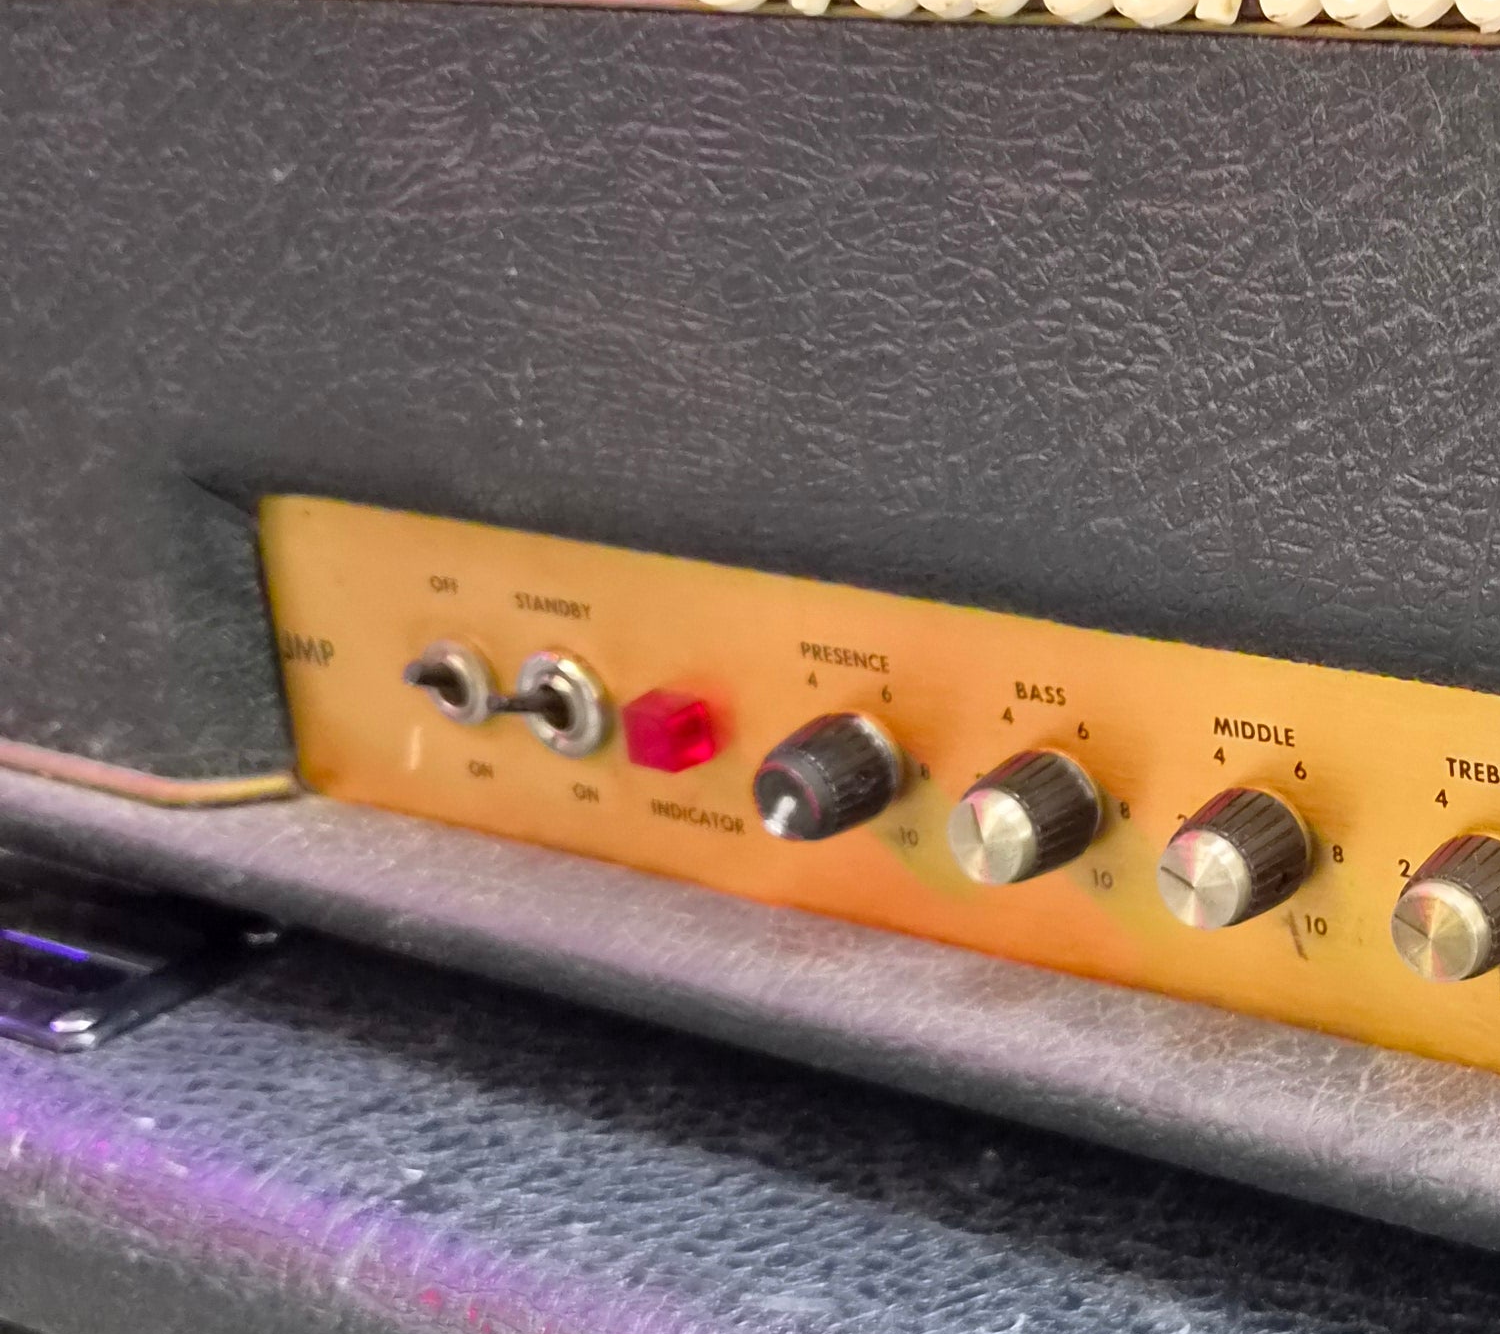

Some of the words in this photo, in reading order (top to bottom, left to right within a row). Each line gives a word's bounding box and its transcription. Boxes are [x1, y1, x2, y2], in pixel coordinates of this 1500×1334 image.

[514, 592, 591, 619] STANDBY
[800, 642, 890, 672] PRESENCE
[807, 671, 818, 688] 4
[881, 685, 892, 702] 6
[1015, 681, 1067, 706] BASS
[1002, 707, 1014, 724] 4
[1077, 721, 1089, 740] 6
[1214, 717, 1296, 747] MIDDLE
[1213, 747, 1226, 765] 4
[468, 760, 495, 779] ON
[1294, 761, 1307, 781] 6
[573, 782, 600, 803] ON
[1435, 789, 1449, 808] 4
[651, 798, 746, 835] INDICATOR
[1119, 801, 1131, 819] 8
[1332, 845, 1345, 863] 8
[1398, 859, 1411, 878] 2
[1093, 869, 1114, 890] 10
[1304, 914, 1328, 936] 10
